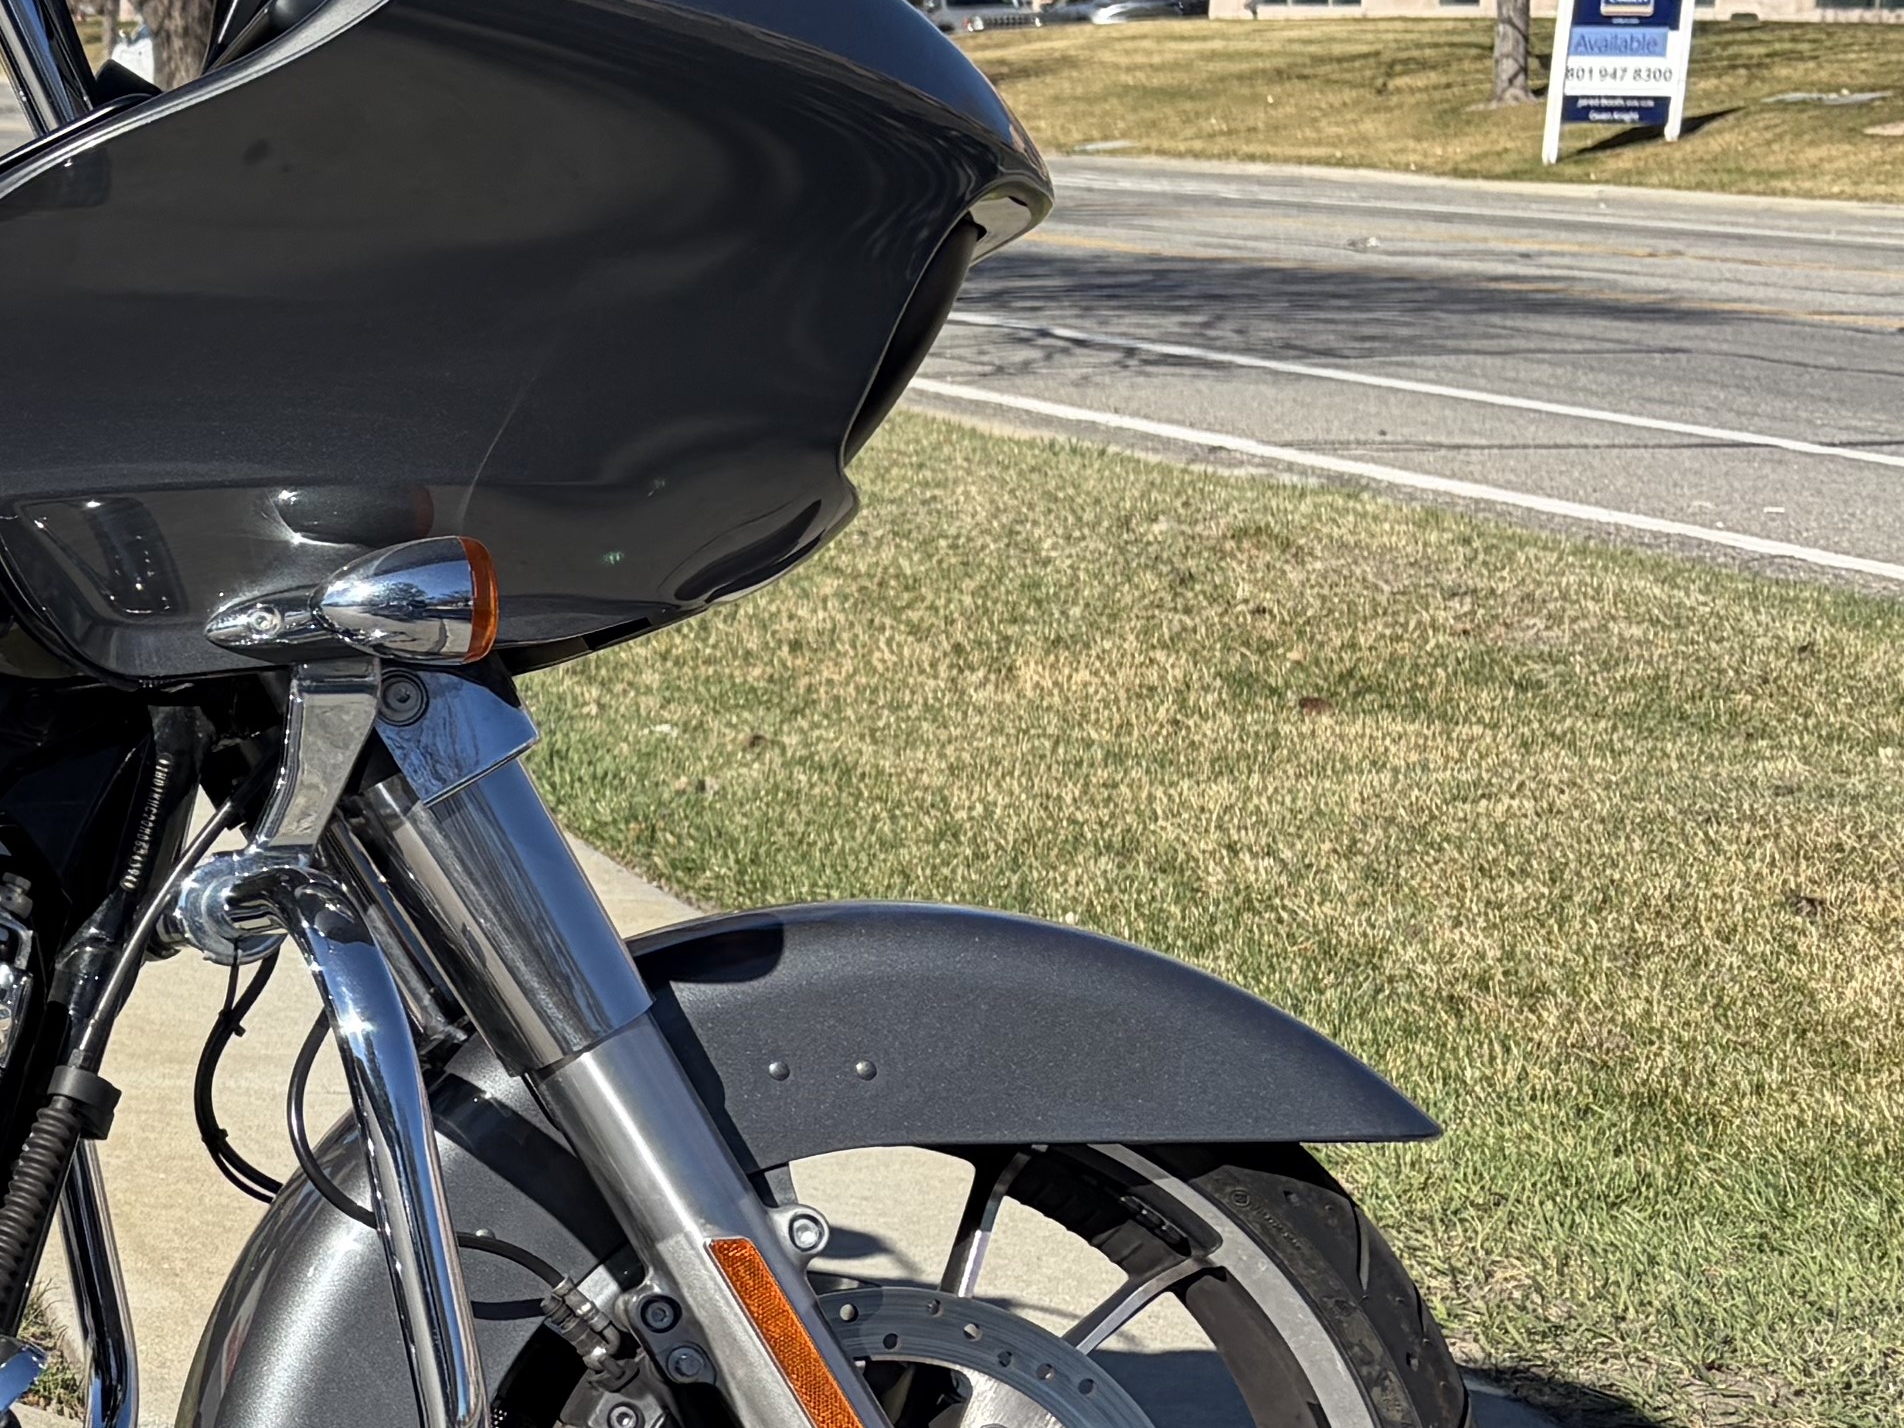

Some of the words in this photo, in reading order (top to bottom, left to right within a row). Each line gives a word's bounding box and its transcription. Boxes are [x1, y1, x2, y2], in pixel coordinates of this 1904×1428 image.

[1574, 33, 1658, 54] Available
[1566, 65, 1594, 82] 801
[1598, 65, 1628, 82] 947
[1632, 65, 1673, 83] 8300
